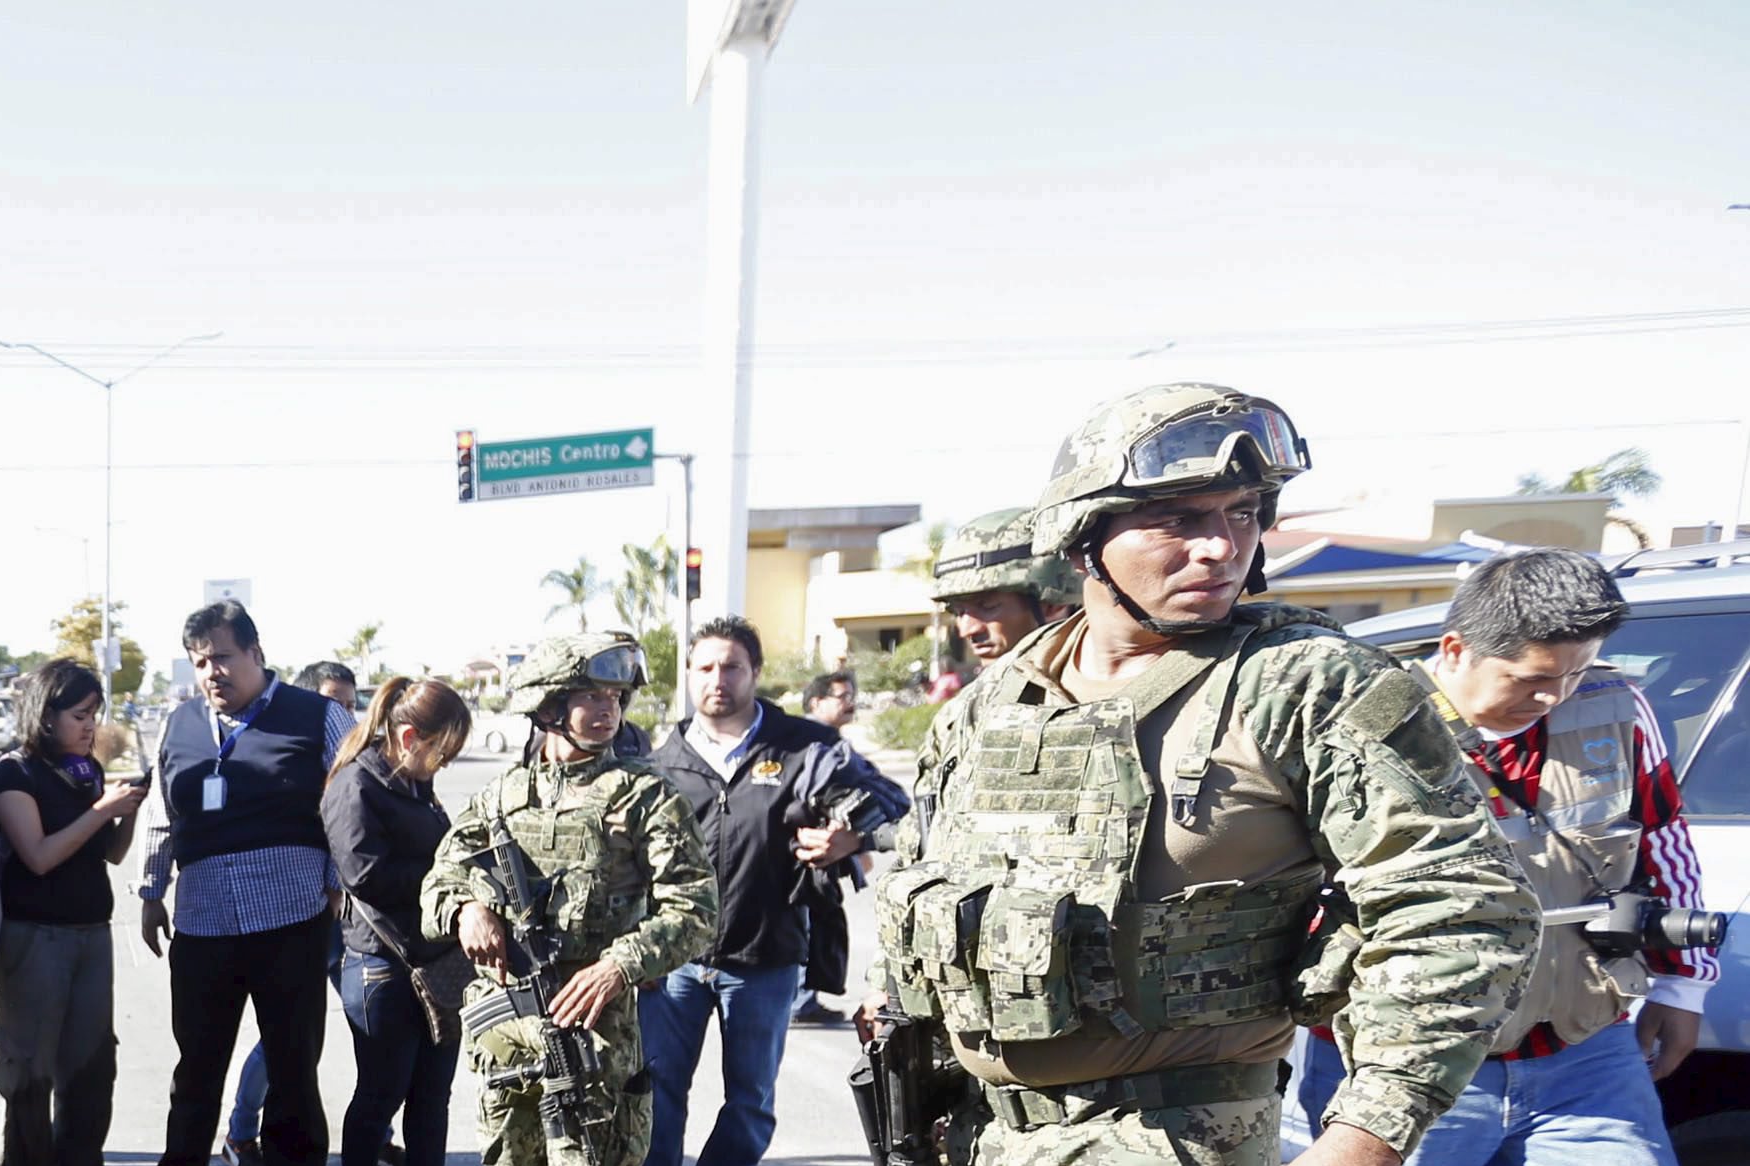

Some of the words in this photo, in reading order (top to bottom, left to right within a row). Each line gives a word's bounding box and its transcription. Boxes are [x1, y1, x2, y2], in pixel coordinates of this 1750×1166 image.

[485, 447, 552, 470] MOCHIS
[560, 443, 620, 463] Centro
[491, 482, 521, 495] BLVD
[529, 477, 579, 493] ANTONIO
[587, 473, 640, 487] ROSALES
